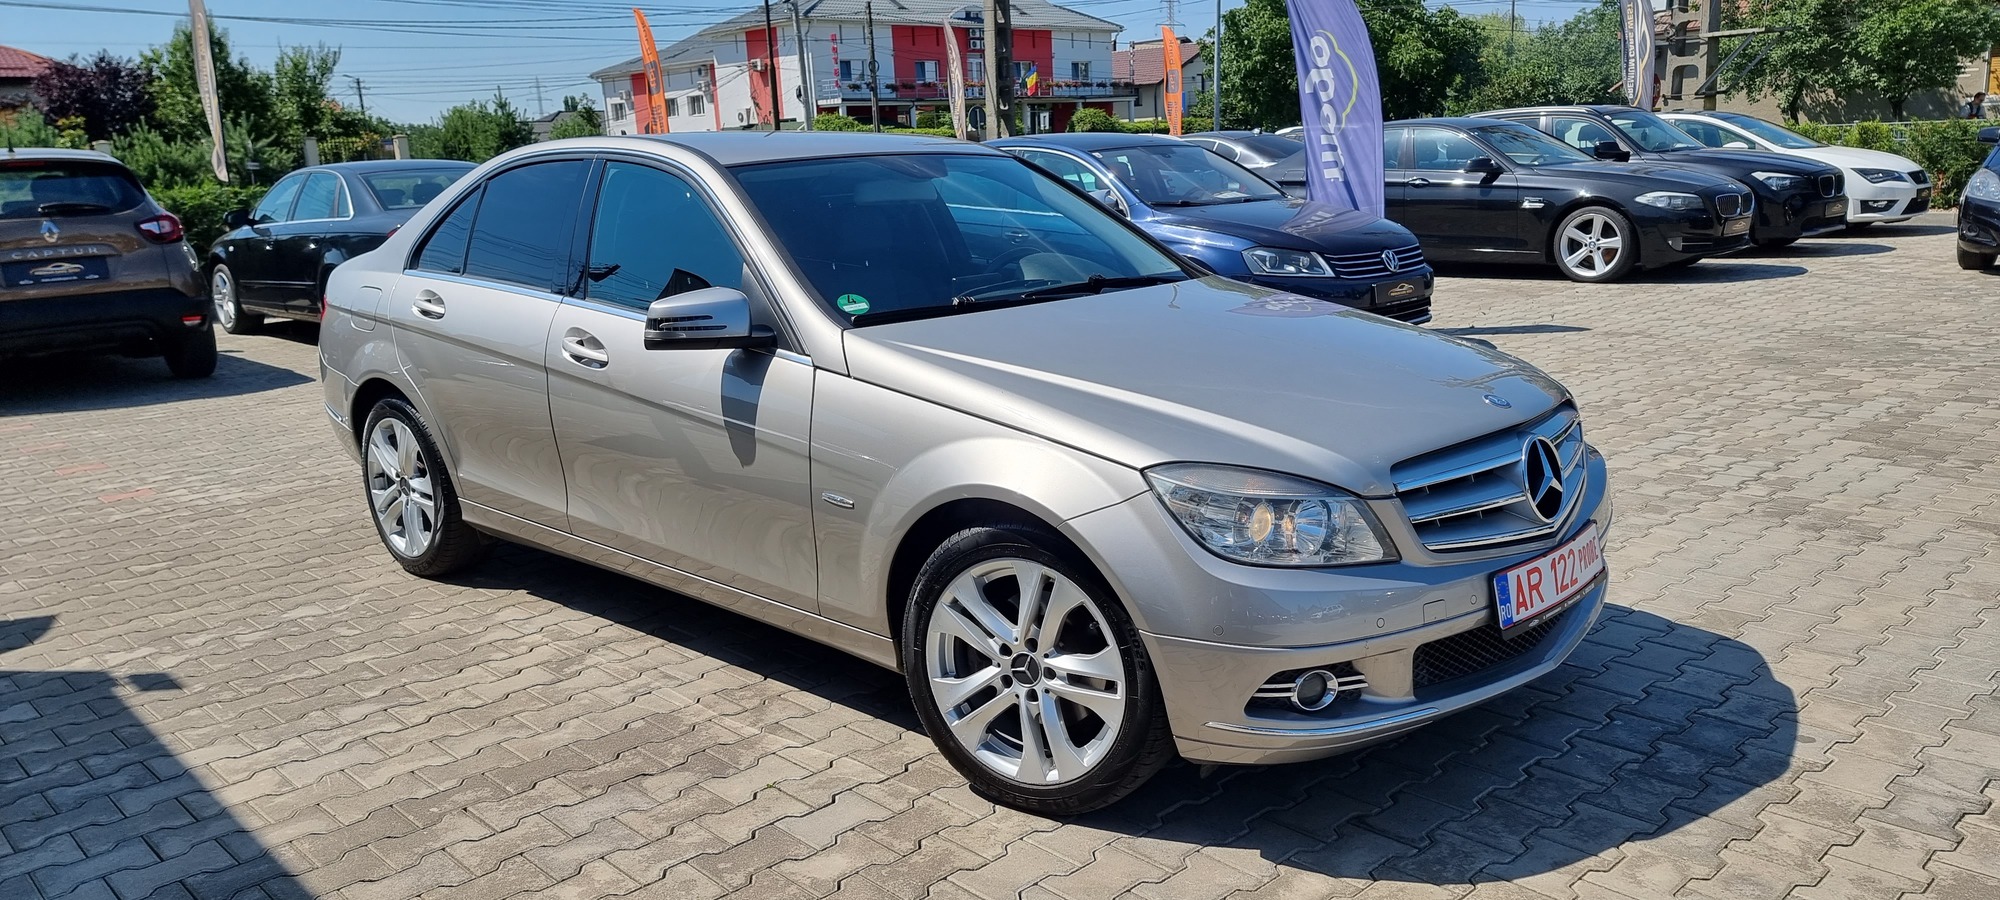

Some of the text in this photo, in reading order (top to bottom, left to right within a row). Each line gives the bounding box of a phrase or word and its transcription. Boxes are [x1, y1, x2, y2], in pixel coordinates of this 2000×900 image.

[11, 246, 99, 260] CAPTUR
[847, 294, 857, 304] 4
[1515, 536, 1599, 615] AR 122 PROBE
[1500, 603, 1512, 621] RO
